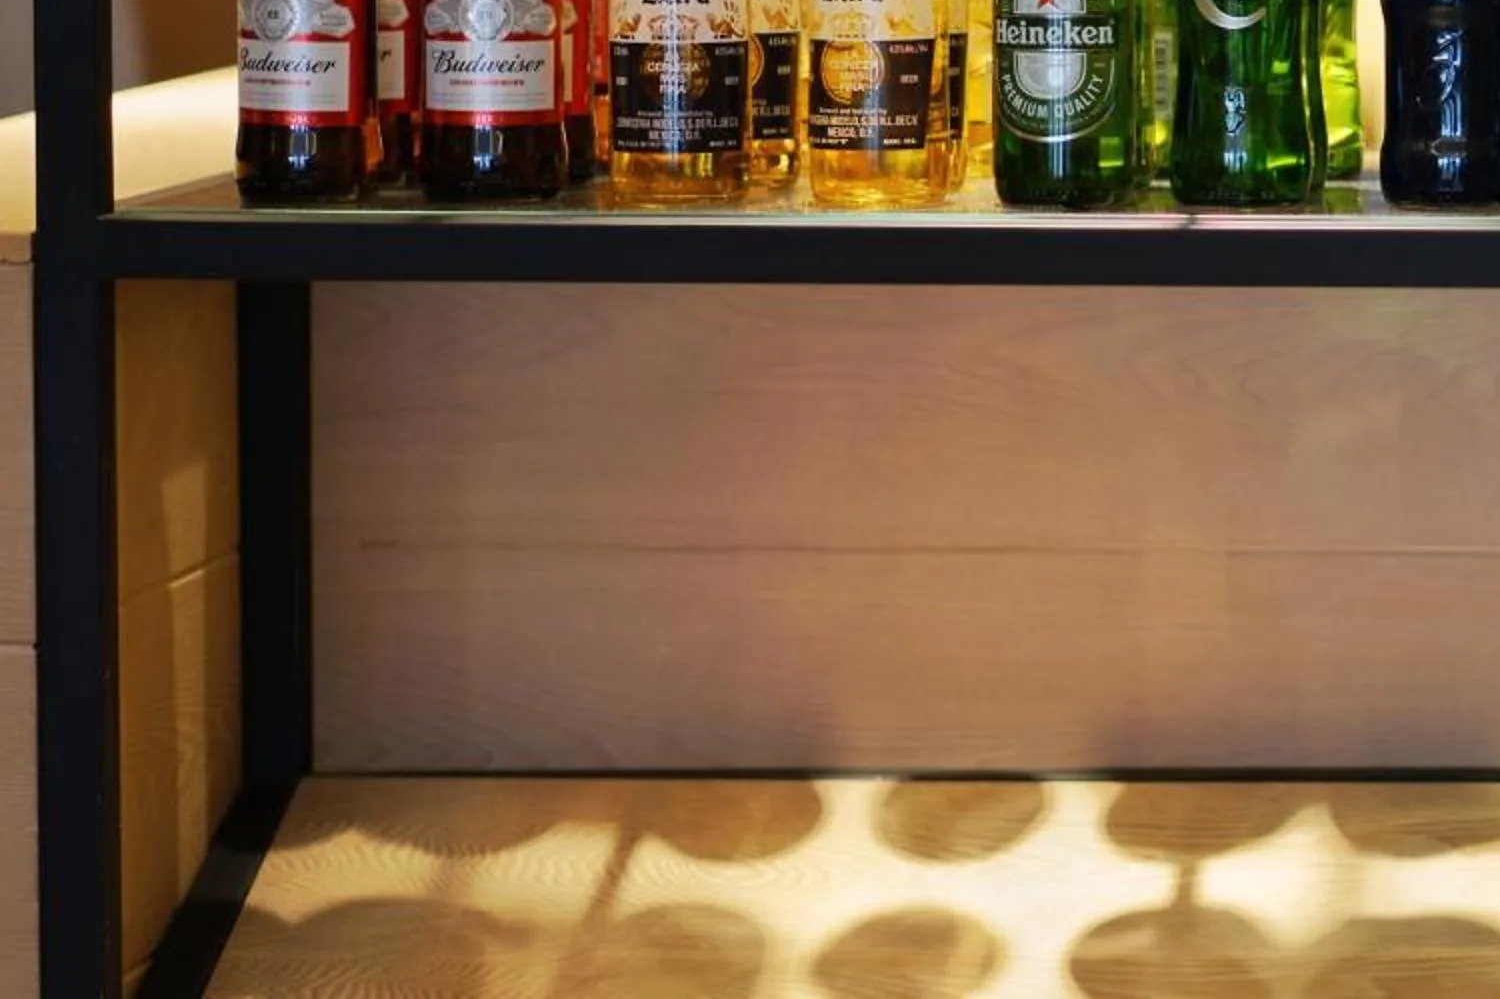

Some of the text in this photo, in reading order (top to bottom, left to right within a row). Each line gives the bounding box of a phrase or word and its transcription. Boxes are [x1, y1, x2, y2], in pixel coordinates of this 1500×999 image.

[995, 17, 1115, 45] Heineken
[431, 49, 545, 75] Budweiser
[1002, 74, 1104, 118] PREMIUM QUALITY
